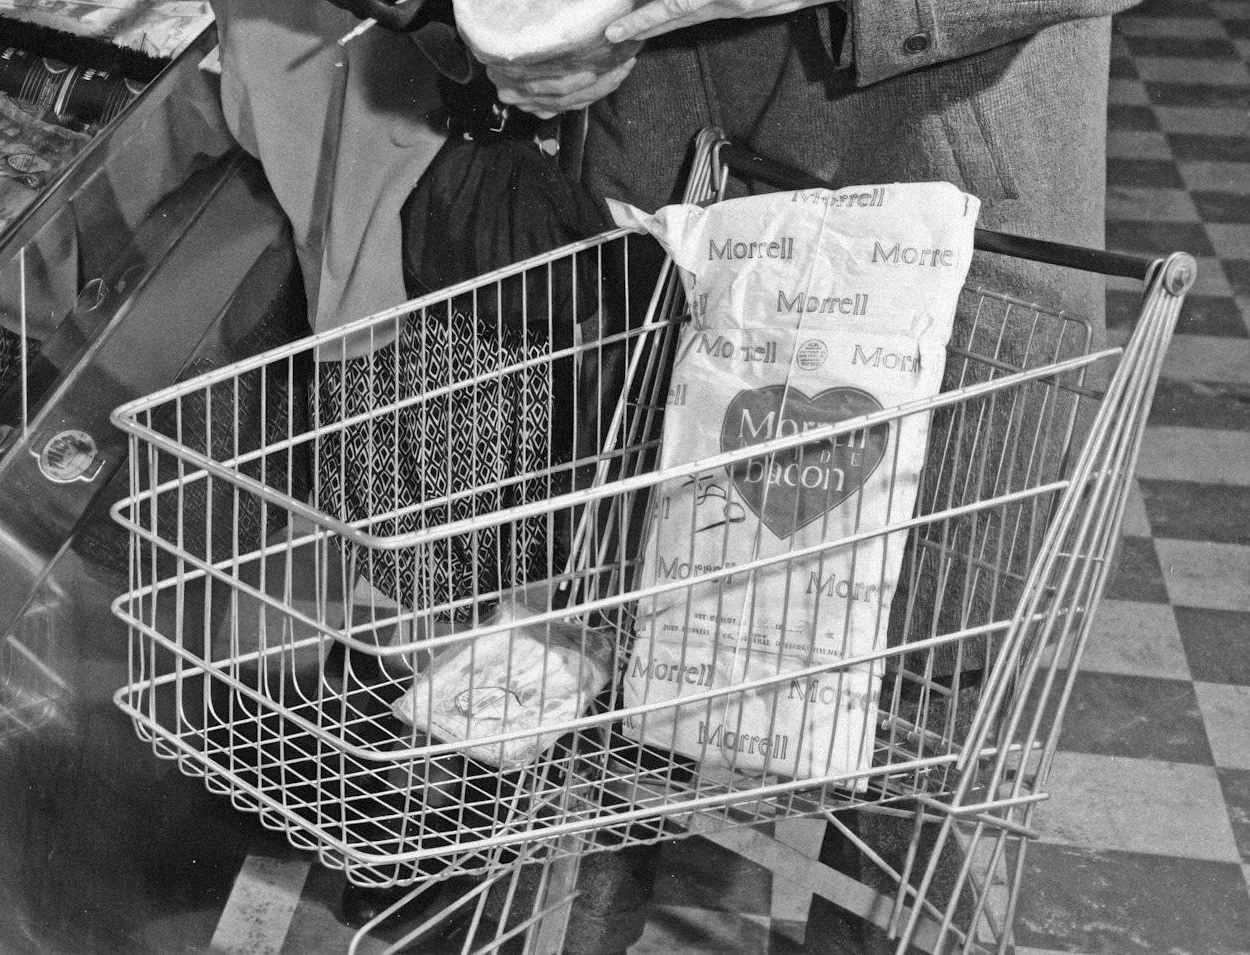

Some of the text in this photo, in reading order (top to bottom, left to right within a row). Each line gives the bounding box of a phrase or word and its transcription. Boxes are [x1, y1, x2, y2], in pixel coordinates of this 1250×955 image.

[707, 237, 794, 261] Morrell
[776, 289, 869, 316] Morrell
[695, 333, 777, 364] Morell
[631, 655, 713, 687] Morrell
[697, 721, 789, 760] Morrell
